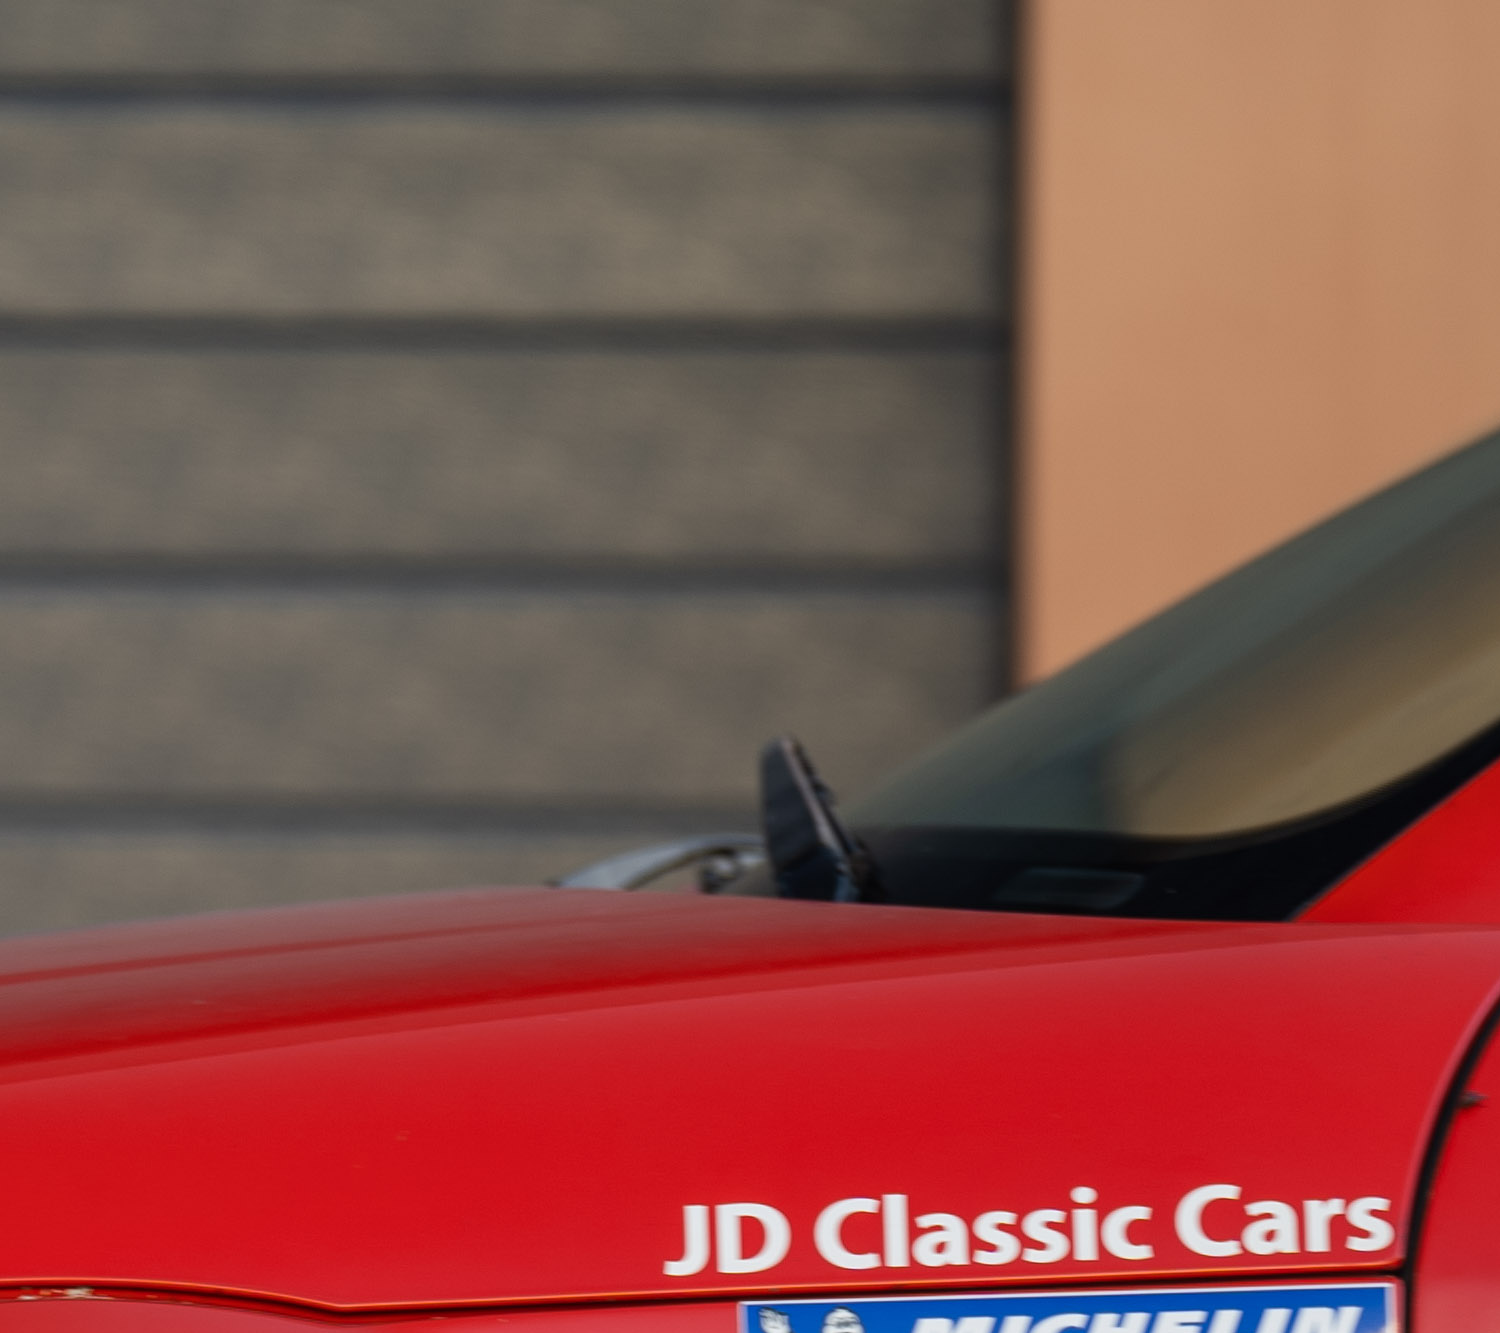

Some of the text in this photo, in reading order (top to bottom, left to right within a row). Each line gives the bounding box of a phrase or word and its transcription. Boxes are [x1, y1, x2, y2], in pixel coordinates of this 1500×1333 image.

[663, 1184, 1397, 1277] JD Classic Cars
